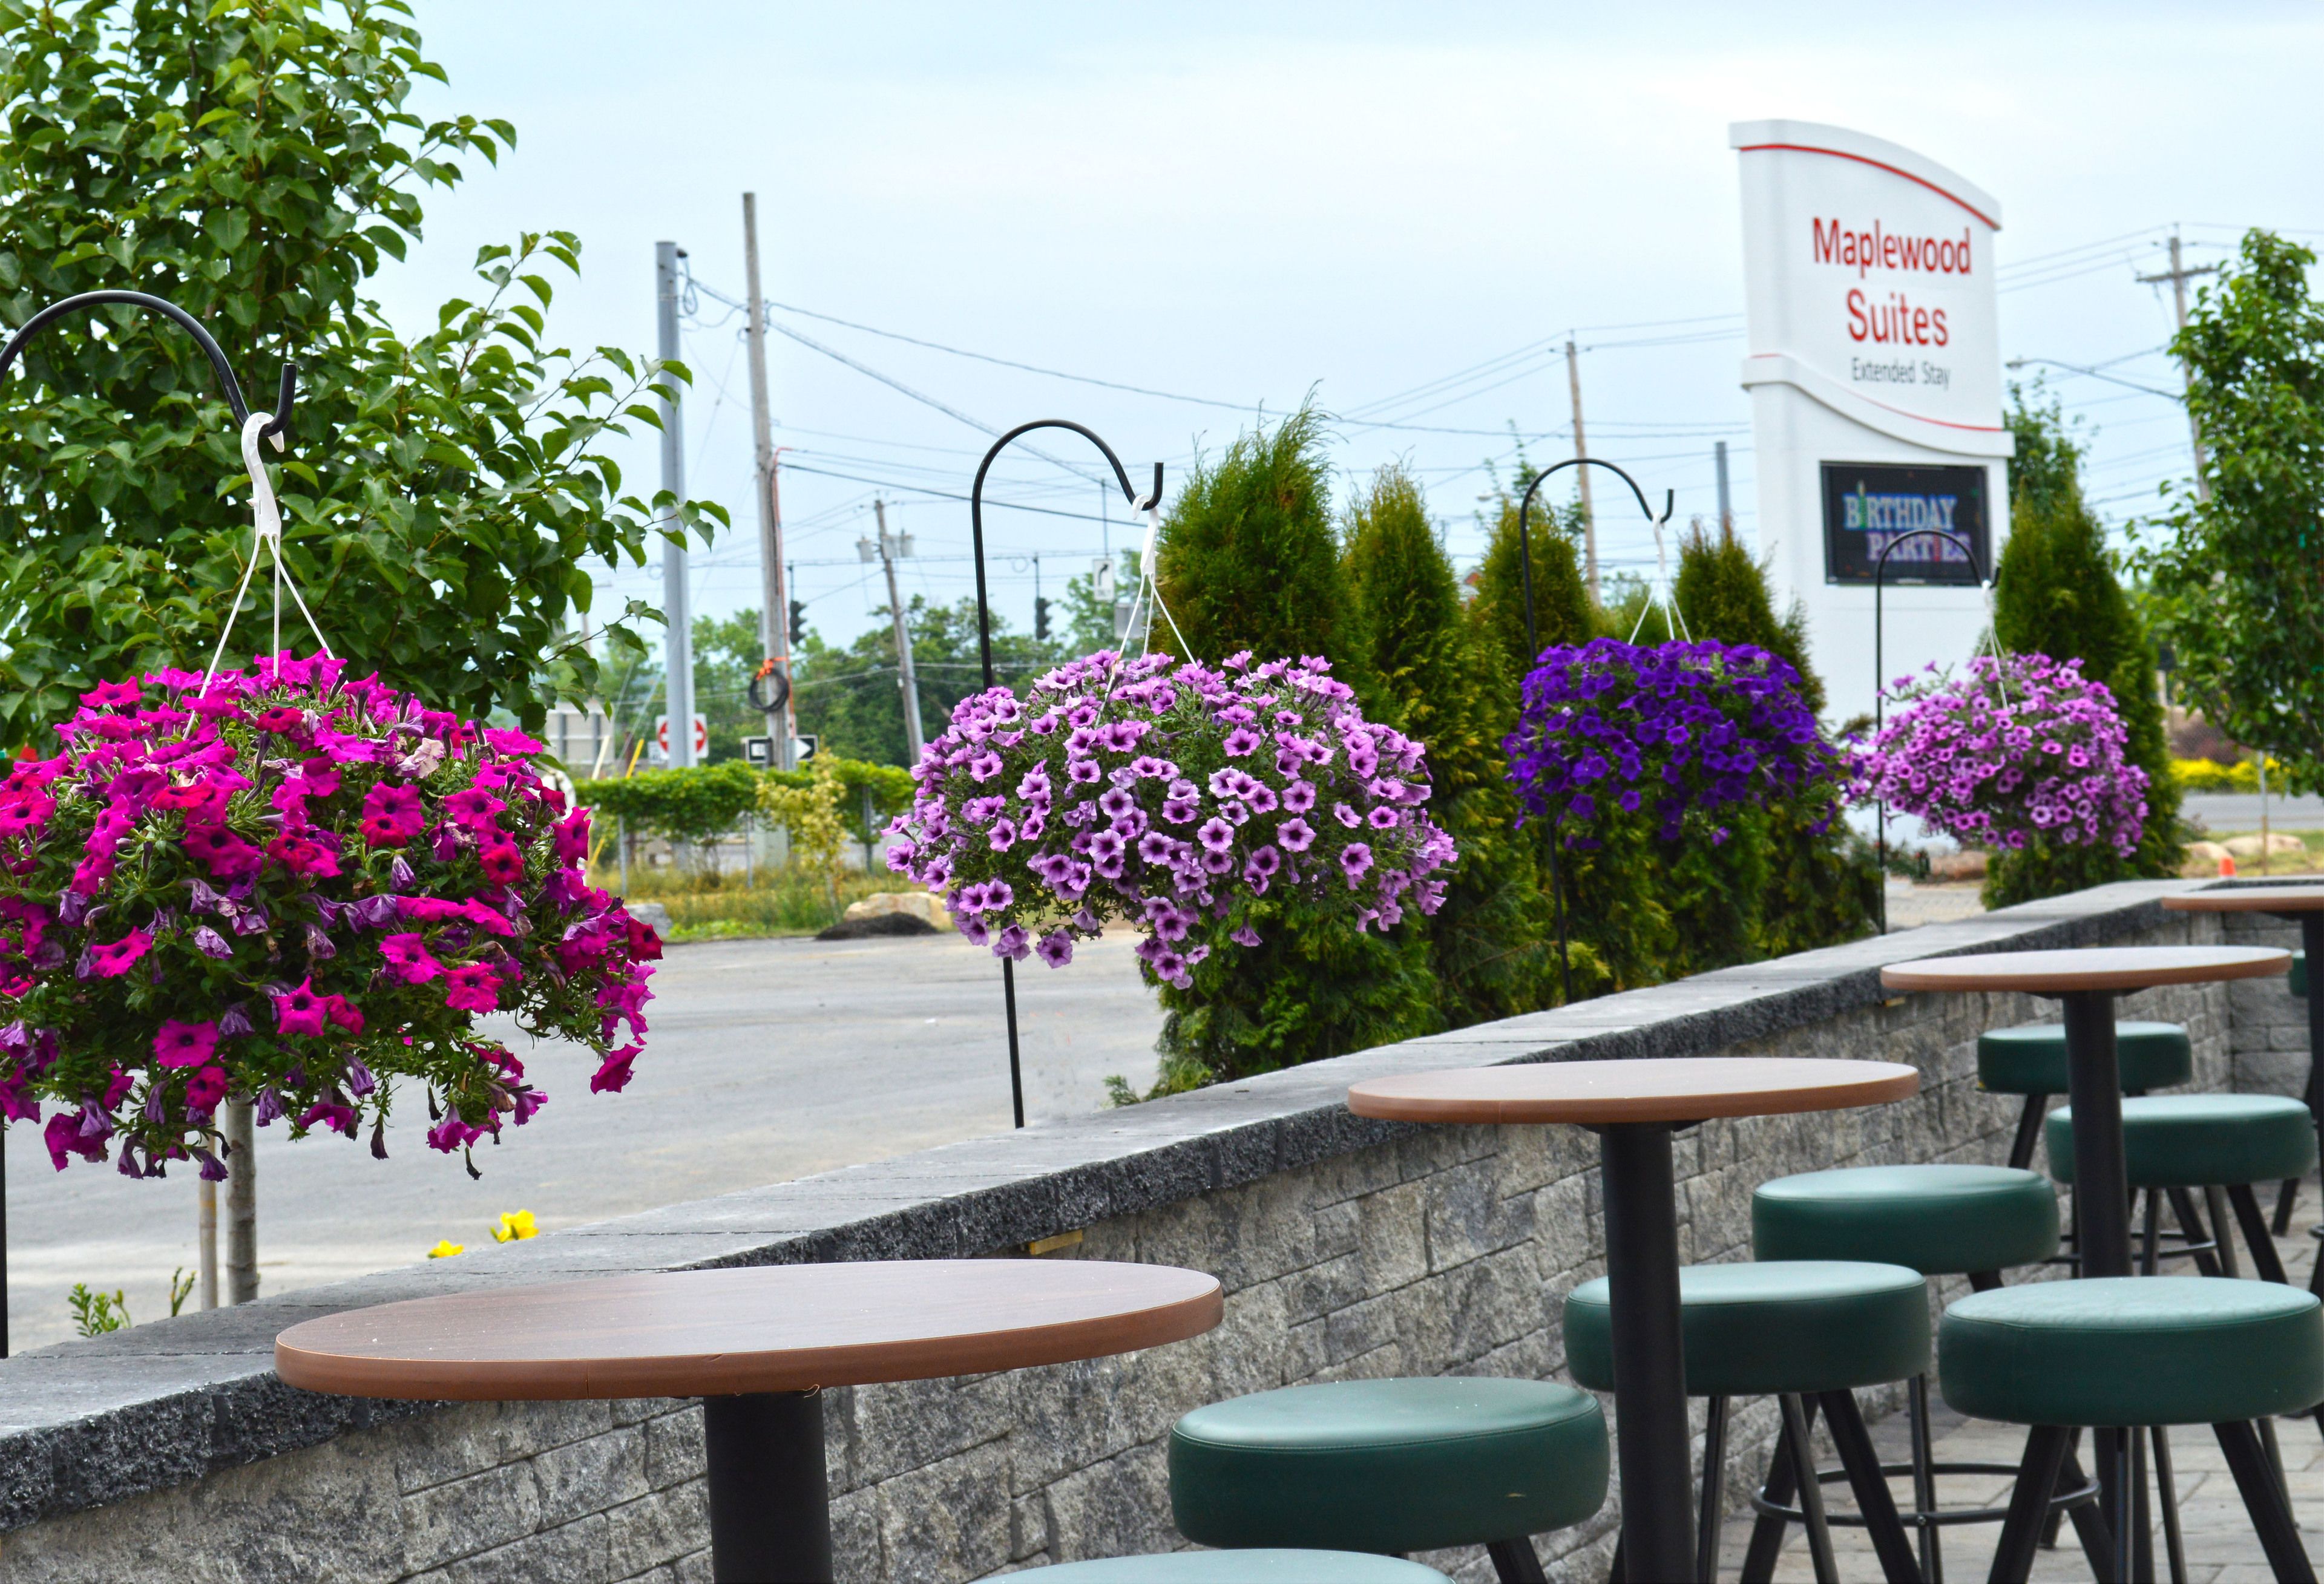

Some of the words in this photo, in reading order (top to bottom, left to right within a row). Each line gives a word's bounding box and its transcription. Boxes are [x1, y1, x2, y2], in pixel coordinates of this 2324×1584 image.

[1813, 217, 1972, 279] Maplewood
[1846, 288, 1949, 347] Suites
[1851, 356, 1916, 385] Extended
[1921, 360, 1951, 391] Stay
[1843, 490, 1958, 530] BIRTHDAY
